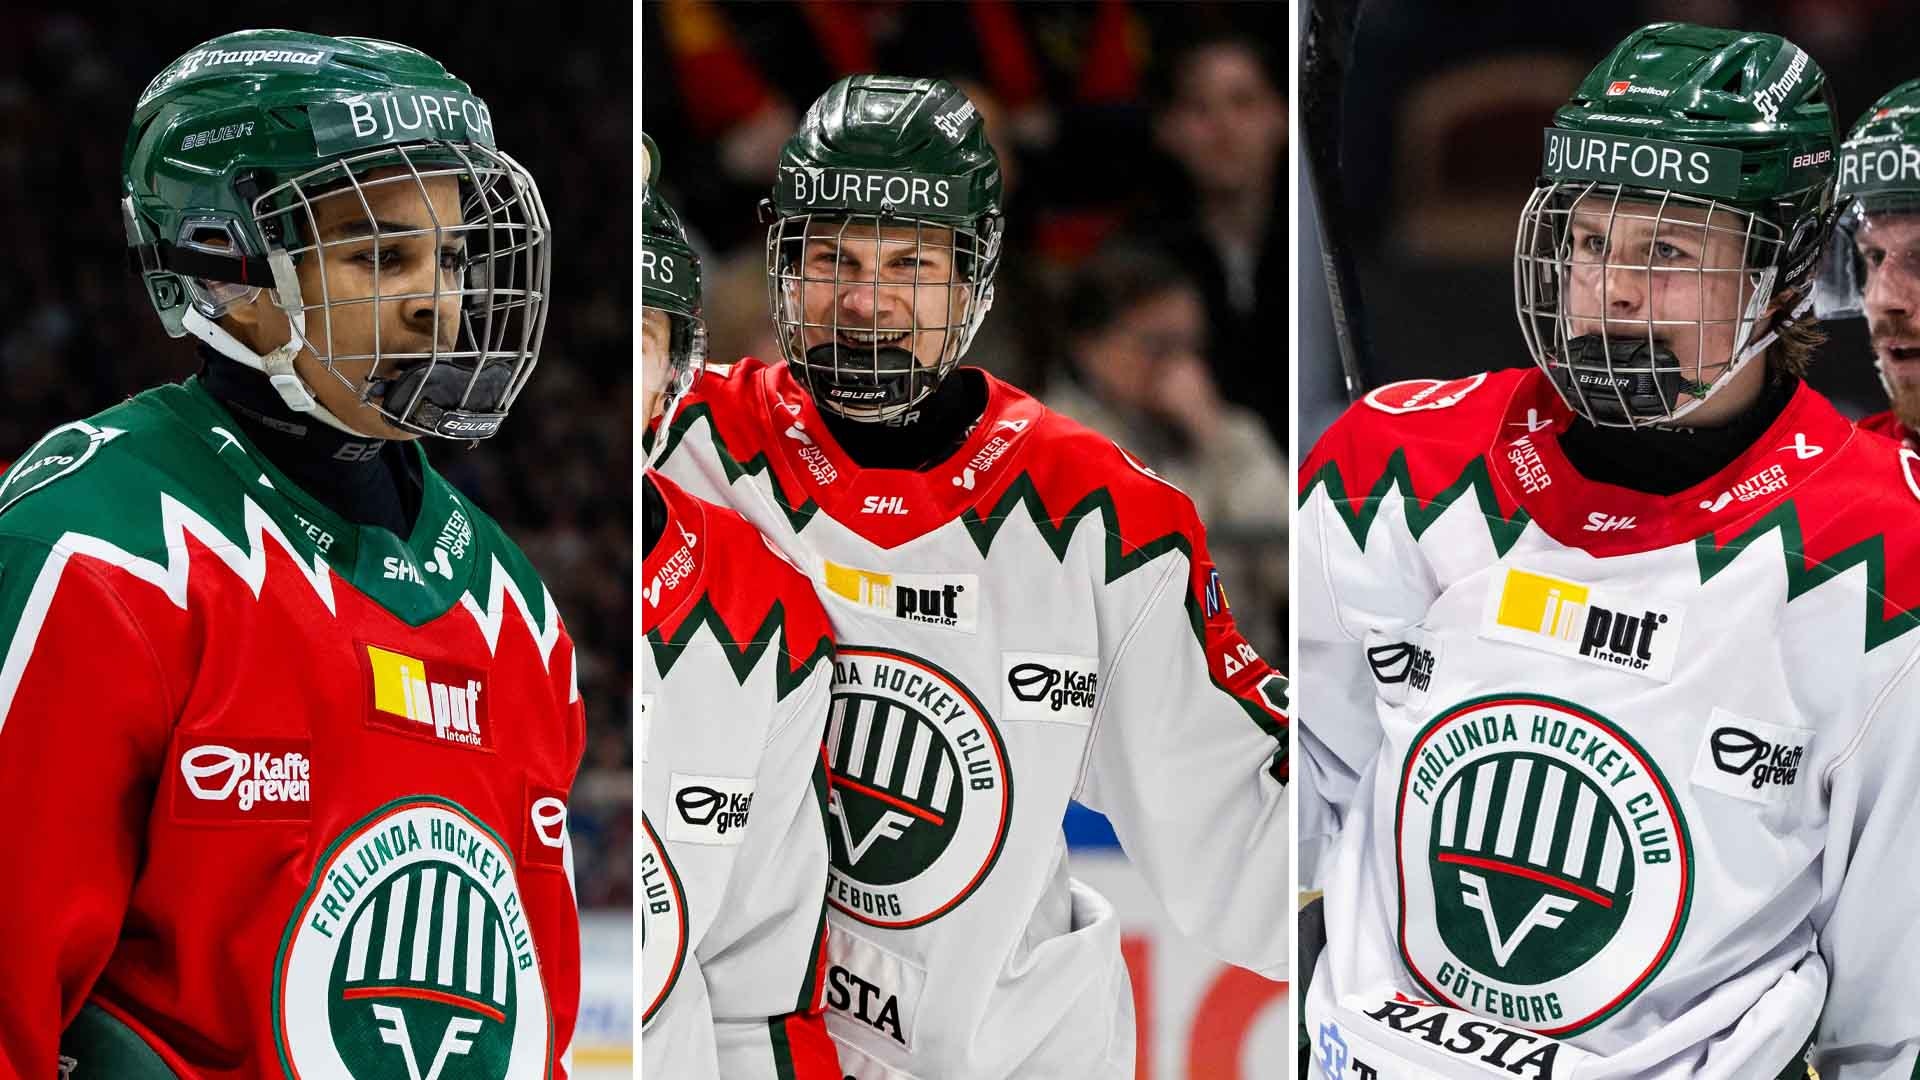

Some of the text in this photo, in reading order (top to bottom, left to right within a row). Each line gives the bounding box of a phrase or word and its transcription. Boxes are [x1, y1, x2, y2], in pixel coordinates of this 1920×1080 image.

[350, 95, 494, 140] BJURFOR
[1547, 135, 1711, 184] BJURFORS
[1792, 150, 1831, 169] BAUER
[1838, 148, 1920, 185] RFOR
[794, 172, 950, 208] BJURFORS
[829, 388, 887, 400] BAUER
[797, 447, 831, 487] SPORT
[808, 445, 839, 483] INTER
[968, 436, 1006, 469] INTER
[1507, 448, 1541, 495] SPORT
[1731, 464, 1785, 497] INTER
[1738, 475, 1789, 503] SPORT
[860, 495, 911, 516] SHL
[1583, 512, 1638, 532] SHL
[436, 509, 465, 550] INTER
[658, 545, 691, 581] INTER
[1063, 670, 1097, 692] Kaff
[1050, 688, 1096, 712] greve
[873, 664, 995, 791] HOCKEY CLUB
[253, 752, 310, 780] Kaffe
[1770, 743, 1804, 768] Kaff
[1412, 712, 1672, 866] FRÖLUNDA HOCKEY CLUB
[1751, 763, 1798, 790] greve
[238, 779, 311, 811] greven
[716, 811, 750, 834] grev
[311, 817, 533, 971] FRÖLUNDA HOCKEY CLUB
[828, 873, 902, 917] TEBORG
[827, 965, 906, 1045] STA
[1435, 960, 1564, 1022] GÖTEBORG
[1363, 1000, 1561, 1080] RASTA
